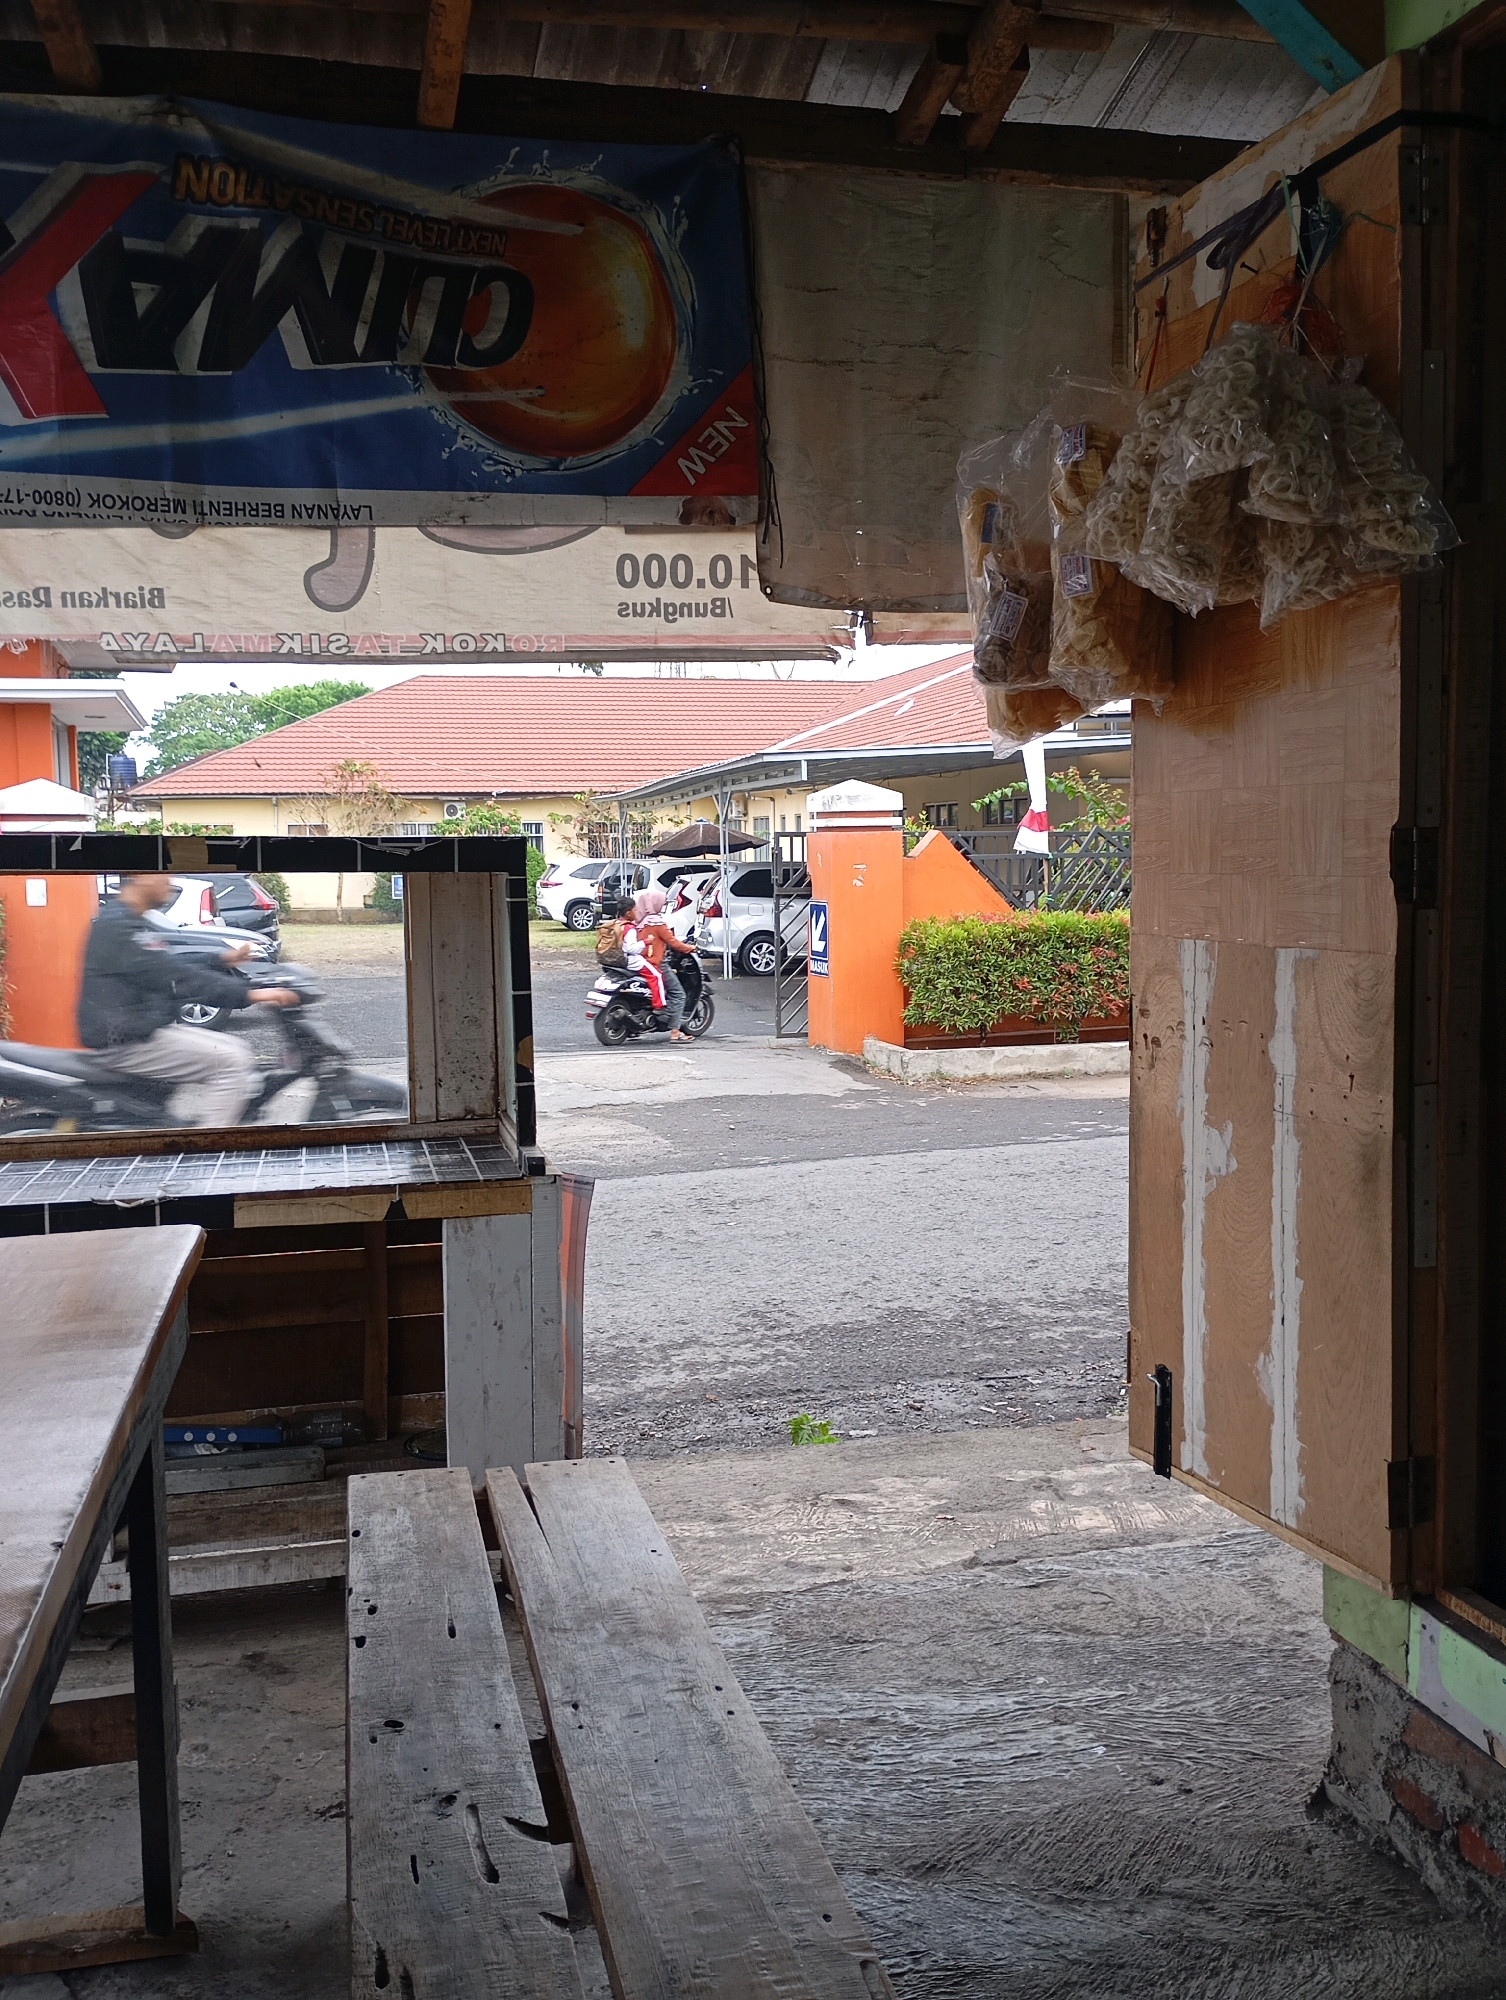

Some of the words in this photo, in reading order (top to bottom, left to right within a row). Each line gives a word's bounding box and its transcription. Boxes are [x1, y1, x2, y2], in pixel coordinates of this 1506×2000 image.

[171, 154, 376, 234] SENSATION
[382, 205, 453, 250] LEVEL
[456, 226, 506, 257] NEXT
[677, 405, 750, 486] NEW
[0, 487, 82, 509] (0800-17
[88, 492, 188, 515] MEROKOK
[193, 500, 286, 520] BERHENTI
[291, 504, 374, 522] LAYANAN
[810, 960, 829, 974] MASUK
